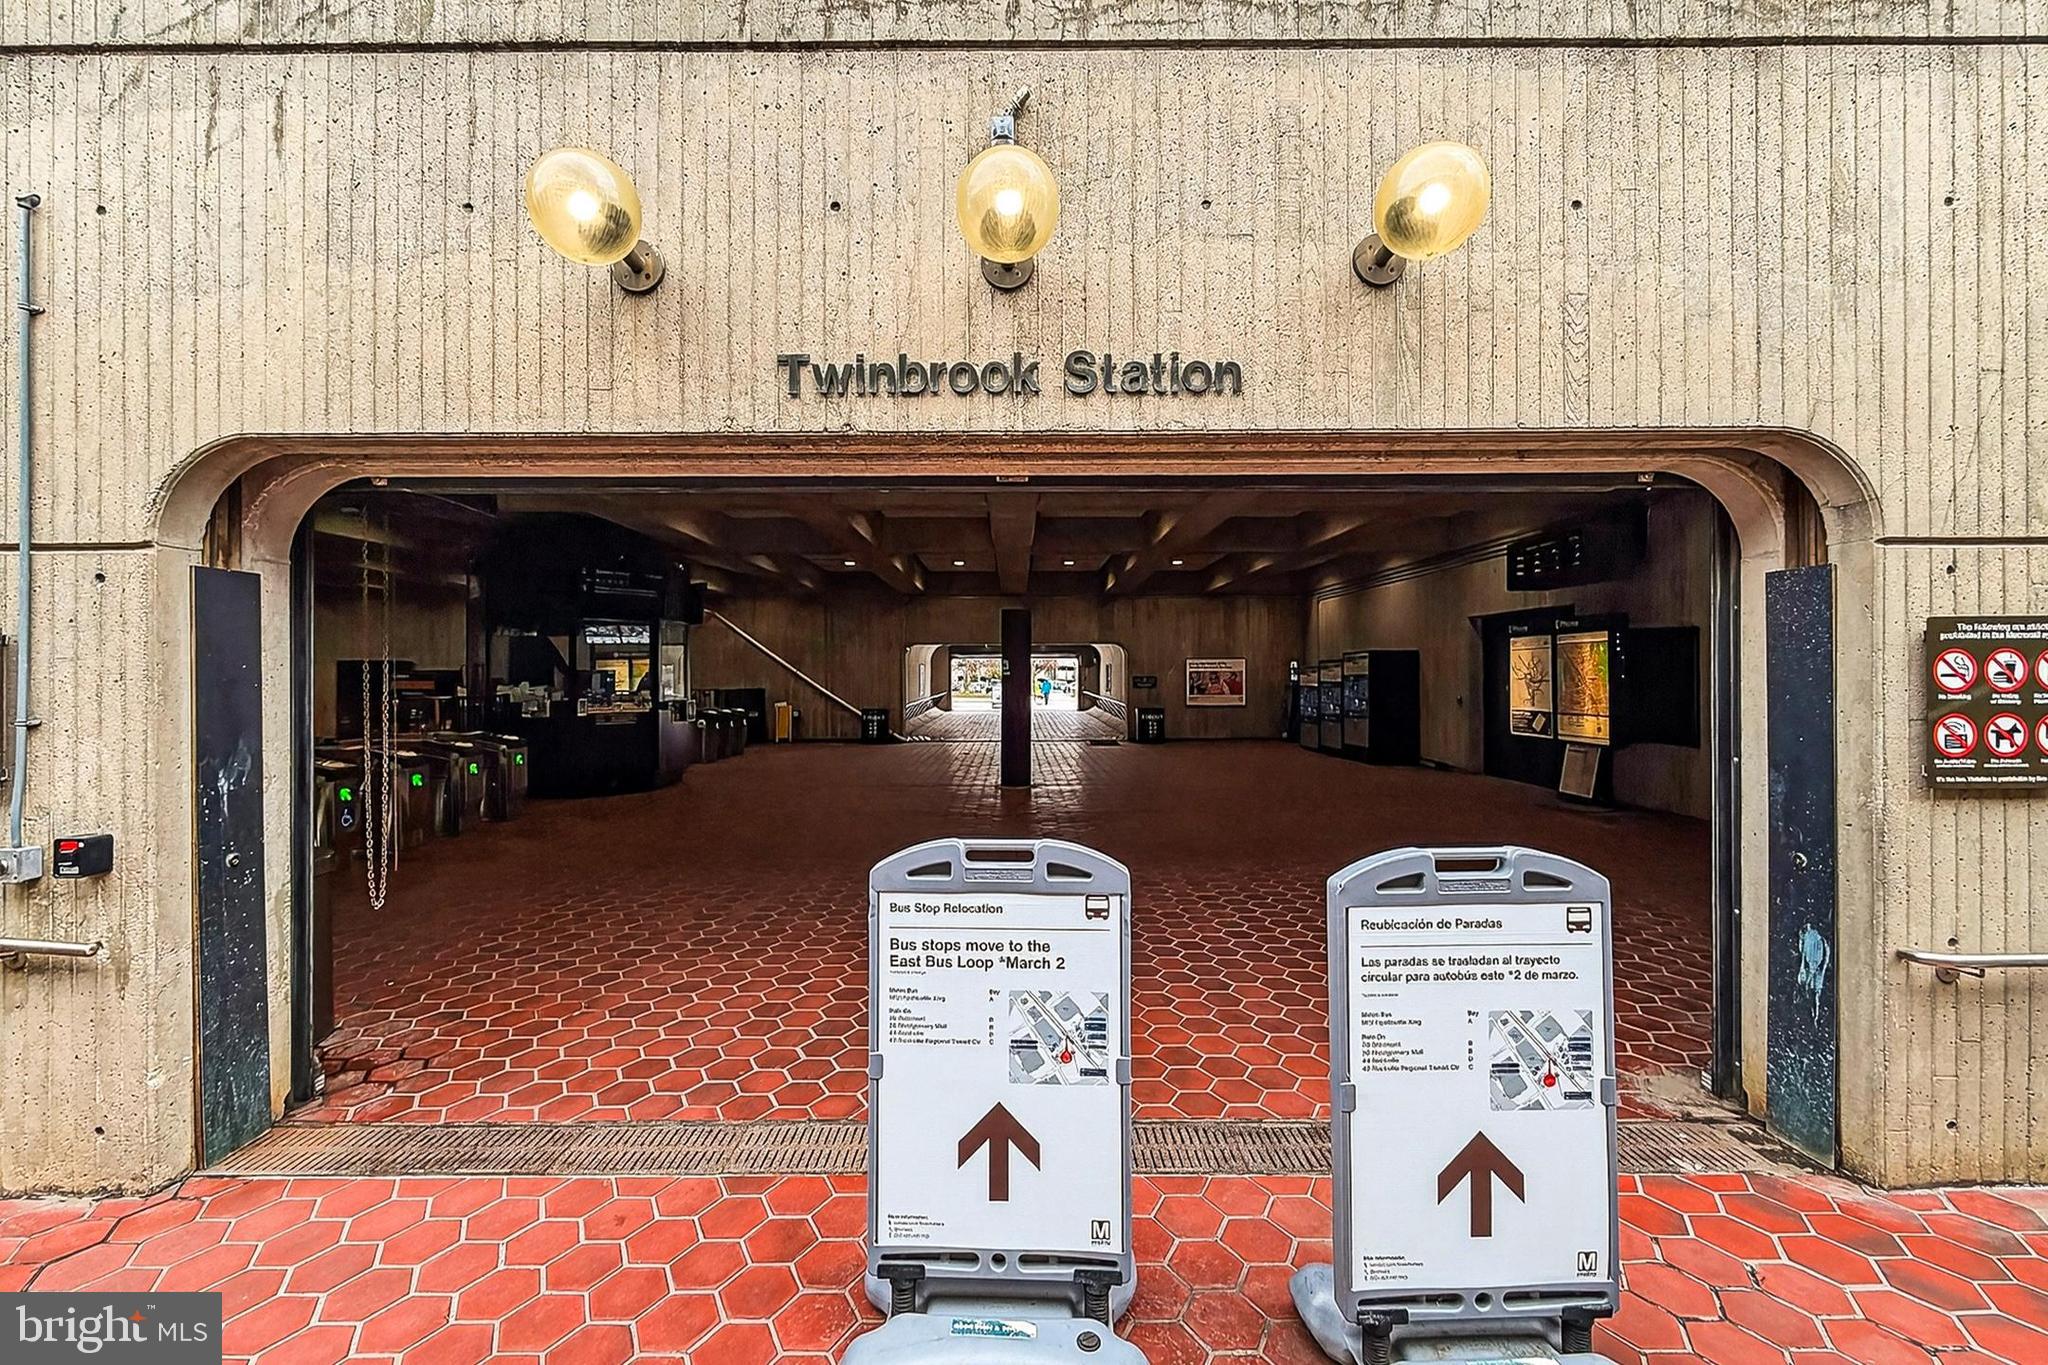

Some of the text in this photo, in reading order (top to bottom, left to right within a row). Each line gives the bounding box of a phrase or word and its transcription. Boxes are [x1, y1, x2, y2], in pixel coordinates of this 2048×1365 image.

[777, 350, 1243, 397] Twinbrook Station
[889, 902, 1004, 916] Bus Stop Relocation
[1361, 918, 1503, 930] Reubicación de Paradas
[889, 937, 1051, 954] Bus stops move to the
[889, 954, 921, 968] East
[925, 955, 953, 968] Bus
[957, 955, 994, 972] Loop
[1055, 957, 1066, 970] 2
[1384, 956, 1429, 969] paradas
[1502, 955, 1512, 966] al
[1515, 955, 1561, 967] trayecto
[1360, 971, 1403, 982] circular
[1405, 972, 1430, 984] para
[1524, 970, 1539, 980] de
[1091, 1220, 1111, 1240] M
[1578, 1251, 1597, 1271] M
